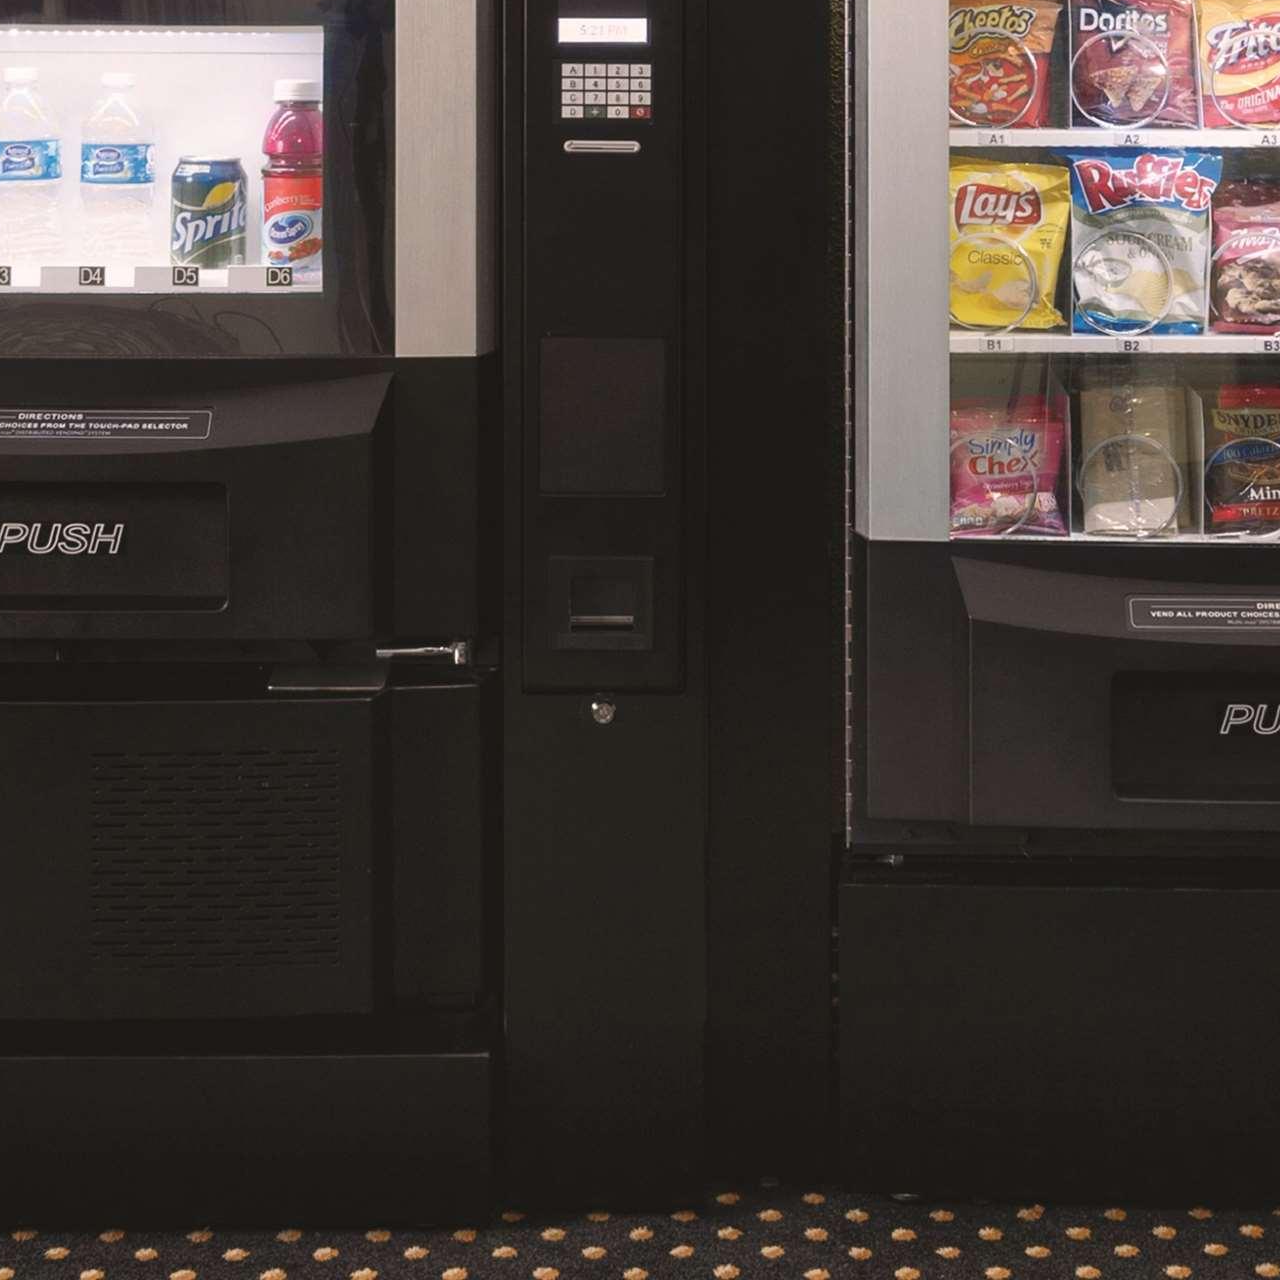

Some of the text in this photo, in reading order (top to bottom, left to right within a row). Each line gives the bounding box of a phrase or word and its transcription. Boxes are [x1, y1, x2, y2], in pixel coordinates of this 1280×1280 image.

[1079, 7, 1167, 31] Doritos
[949, 5, 1035, 51] Cheetos
[989, 134, 1004, 144] A1
[1124, 134, 1140, 144] A2
[1261, 135, 1277, 145] A3
[1073, 153, 1217, 215] Ruffles
[959, 185, 1037, 225] Lay's
[968, 250, 1024, 266] Classic
[80, 268, 102, 284] D4
[174, 268, 197, 284] D5
[267, 268, 290, 284] D6
[987, 340, 1002, 350] B1
[1124, 341, 1140, 351] B2
[1264, 341, 1280, 351] B3
[18, 413, 84, 421] DIRECTIONS
[969, 428, 1036, 456] Simply
[969, 450, 1040, 477] Chex
[1150, 610, 1174, 618] VEND
